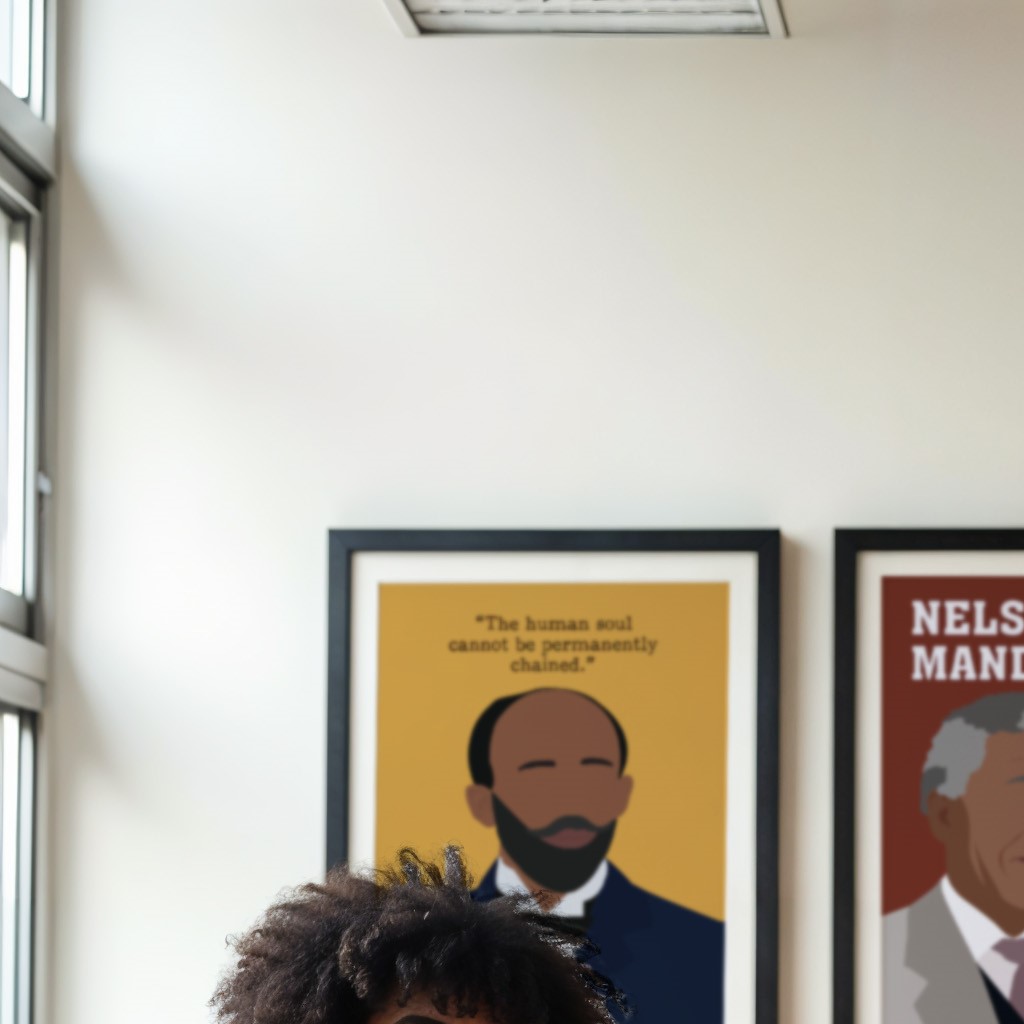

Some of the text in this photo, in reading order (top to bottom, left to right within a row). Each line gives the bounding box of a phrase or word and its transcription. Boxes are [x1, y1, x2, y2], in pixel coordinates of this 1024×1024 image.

[526, 616, 589, 632] human
[596, 616, 632, 631] soul
[448, 636, 658, 656] cannot be permanently
